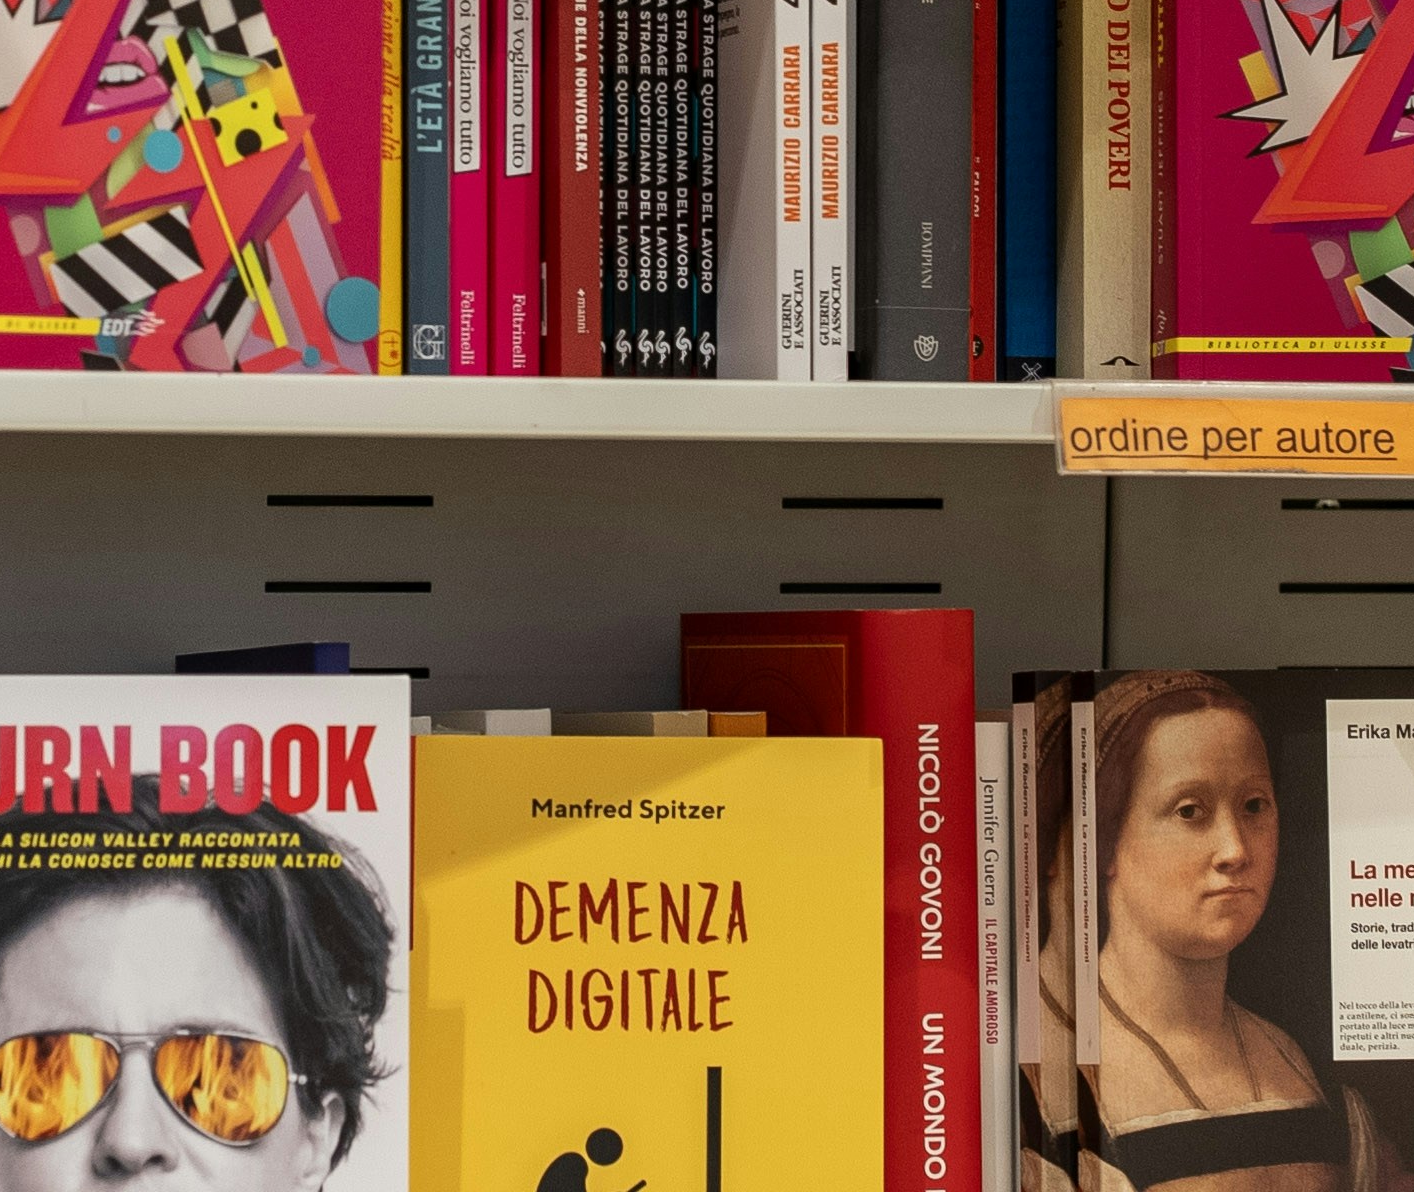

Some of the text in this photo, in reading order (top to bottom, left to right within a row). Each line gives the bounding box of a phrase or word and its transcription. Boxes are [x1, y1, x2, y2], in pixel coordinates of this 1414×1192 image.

[1107, 20, 1131, 72] DEI
[415, 81, 443, 153] L'ETÀ
[783, 45, 801, 222] MAURIZIO CARRARA
[1107, 80, 1131, 191] POVERI
[1070, 419, 1396, 460] ordine per autore
[1347, 724, 1390, 739] Erika
[159, 723, 379, 816] BOOK
[530, 797, 726, 824] Manfred Spitzer
[17, 853, 42, 869] LA
[47, 853, 136, 869] CONOSCE
[142, 853, 196, 869] COME
[201, 853, 277, 869] NESSUN
[282, 853, 343, 869] ALTRO
[19, 832, 96, 849] SILICON
[102, 832, 172, 849] VALLEY
[179, 832, 301, 849] RACCONTATA
[917, 723, 944, 961] NICOLÒ GOVONI
[1350, 860, 1377, 880] La
[512, 877, 749, 945] DEMENZA
[1350, 888, 1403, 908] nelle
[1350, 922, 1388, 935] Storie,
[1351, 939, 1379, 950] delle
[526, 968, 735, 1033] DIGITALE
